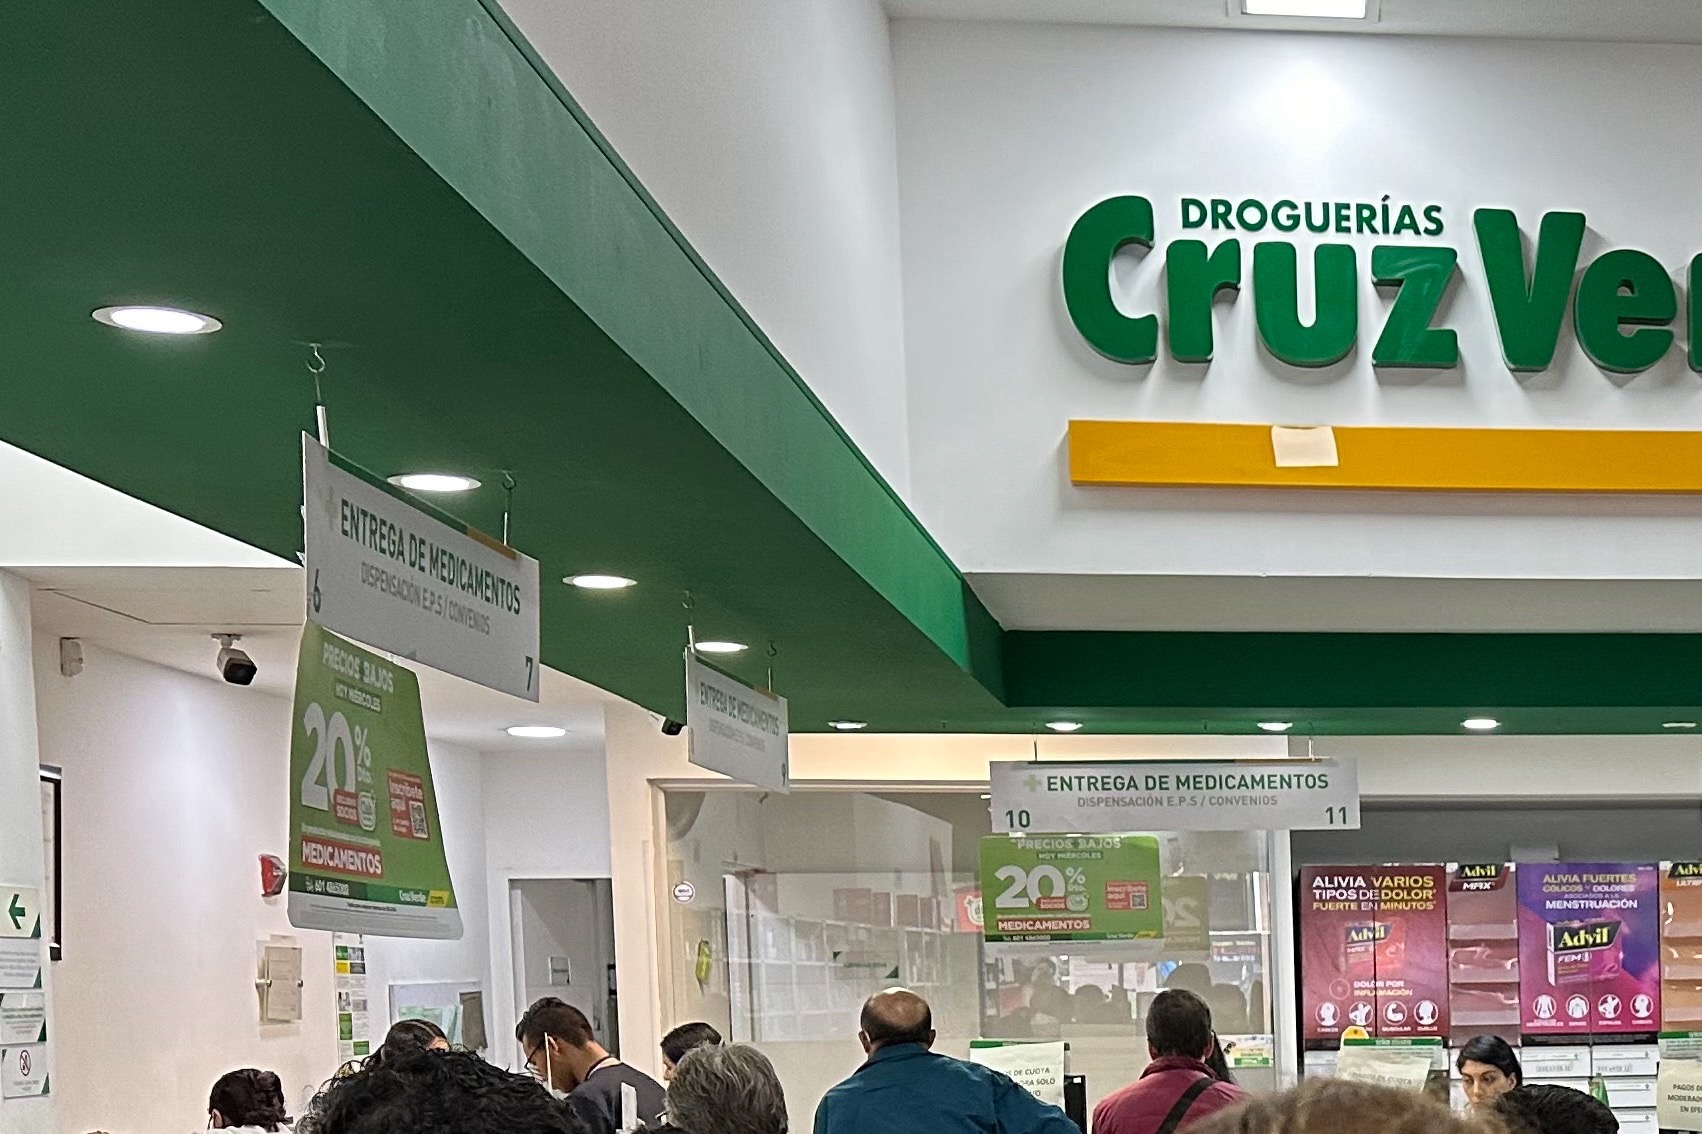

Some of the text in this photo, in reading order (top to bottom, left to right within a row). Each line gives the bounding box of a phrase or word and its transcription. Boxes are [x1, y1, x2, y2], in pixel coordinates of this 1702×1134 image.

[1181, 195, 1444, 237] DROGUERÍAS
[1061, 194, 1461, 370] Cruz
[341, 498, 521, 615] ENTREGA DE MEDICAMENTOS
[313, 568, 322, 613] 6
[360, 561, 422, 606] DISPENSACIÓN
[449, 597, 491, 635] CONVENIOS
[525, 656, 534, 691] 7
[1047, 774, 1328, 792] ENTREGA DE MEDICAMENTOS
[1077, 794, 1163, 808] DISPENSACIÓN
[1208, 795, 1277, 807] CONVENIOS
[1005, 810, 1031, 828] 10
[1325, 806, 1348, 825] 11
[302, 841, 382, 875] MEDICAMENTOS
[1461, 864, 1496, 878] Advil
[1543, 873, 1637, 883] ALIVIA FUERTES
[994, 864, 1066, 909] 20
[1313, 876, 1434, 888] ALIVIA VARIOS
[1313, 889, 1358, 900] TIPOS
[1360, 889, 1380, 900] DE
[1313, 901, 1358, 911] FUERTE
[1361, 901, 1378, 911] EN
[1545, 898, 1638, 910] MENSTRUACIÓN
[998, 920, 1091, 931] MEDICAMENTOS
[1349, 925, 1385, 942] Advil
[1559, 926, 1610, 949] Advil
[1673, 1083, 1695, 1092] PAGOS
